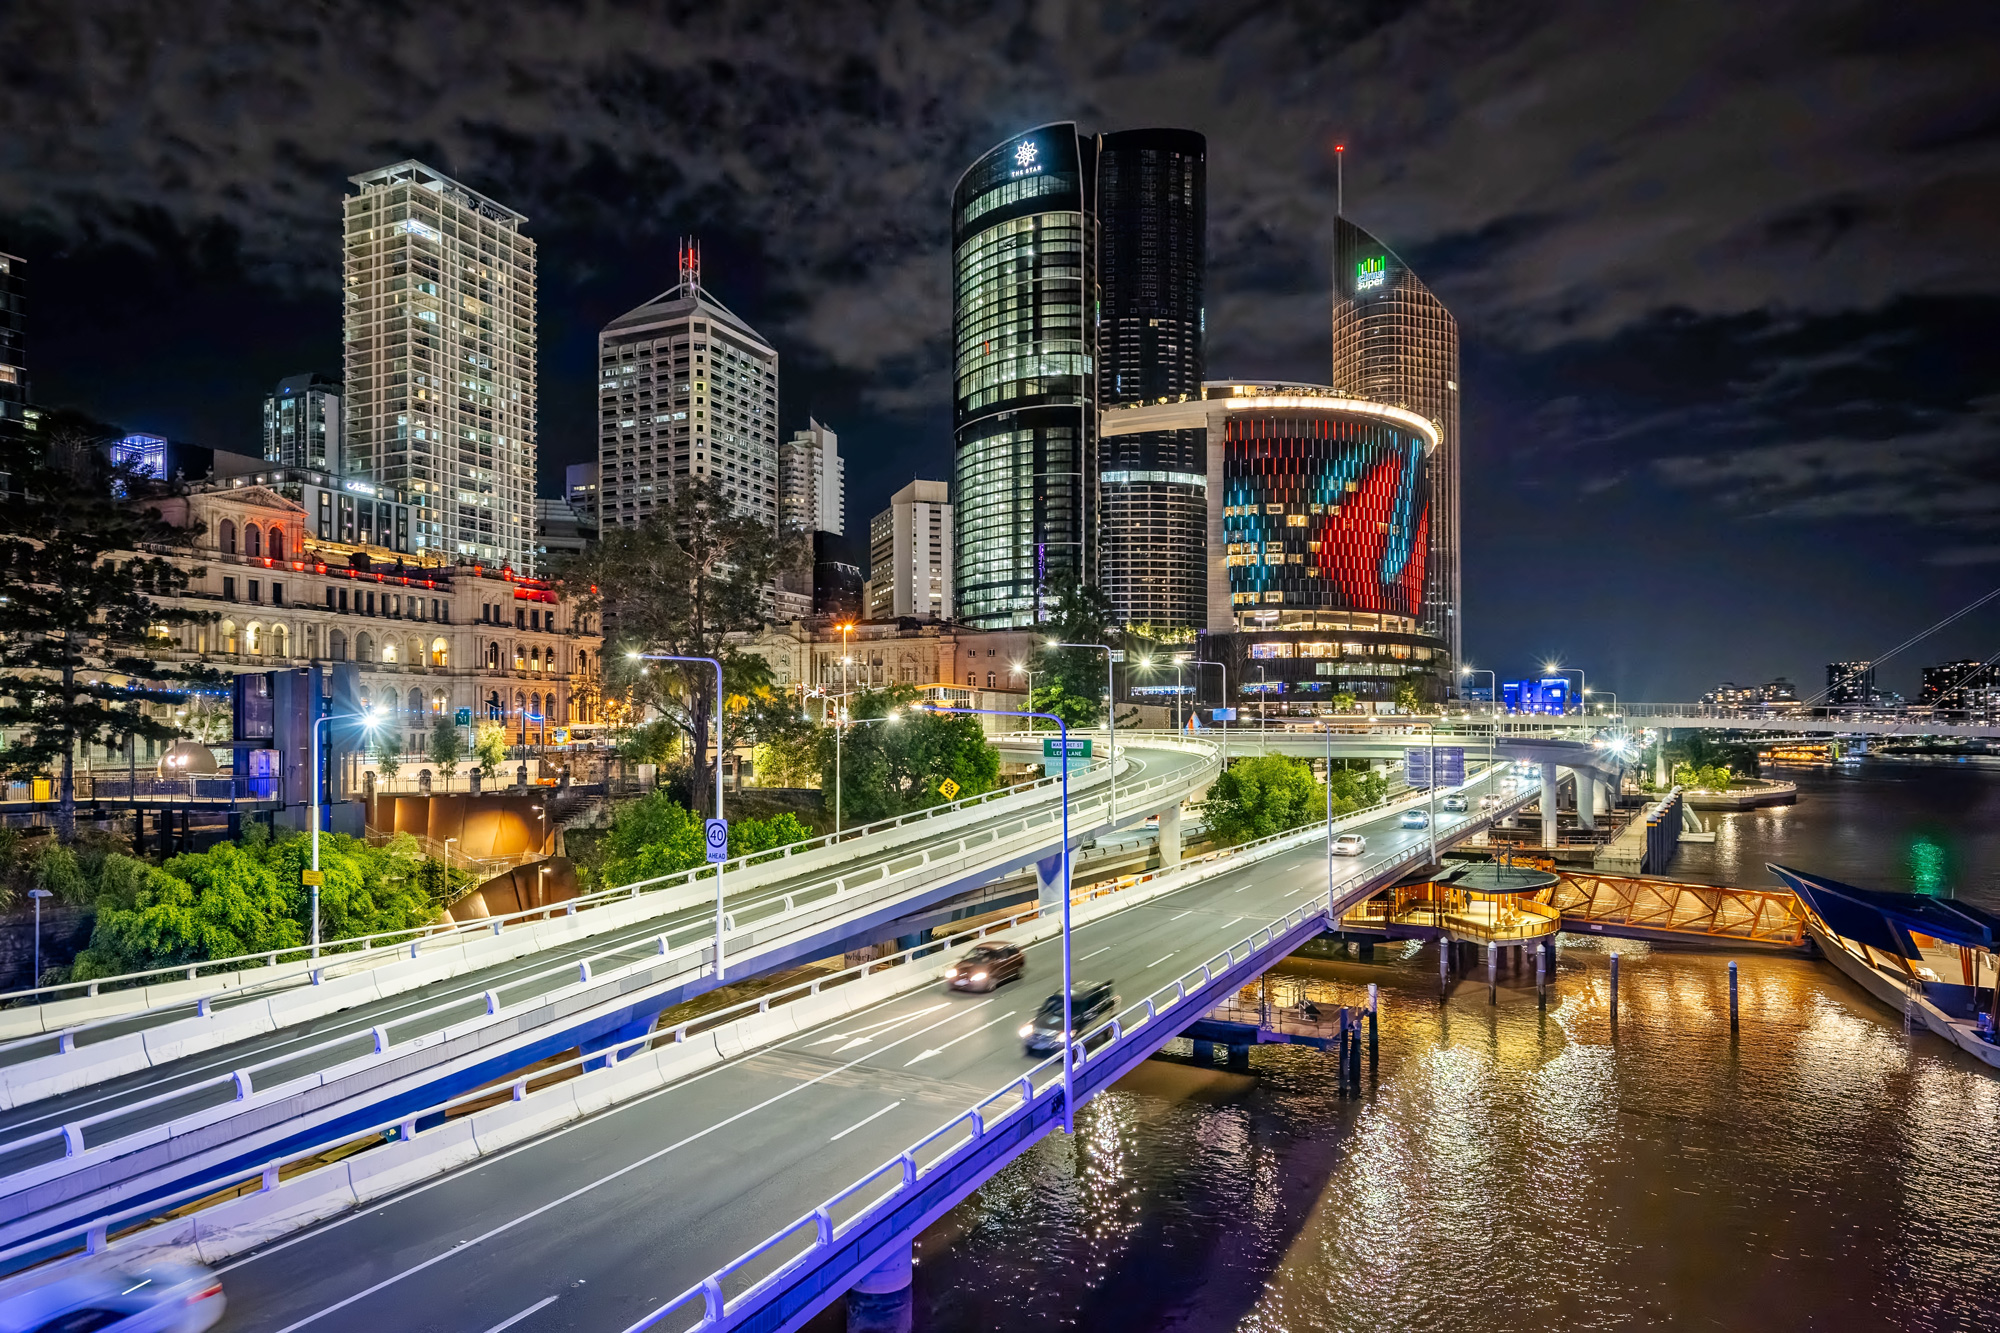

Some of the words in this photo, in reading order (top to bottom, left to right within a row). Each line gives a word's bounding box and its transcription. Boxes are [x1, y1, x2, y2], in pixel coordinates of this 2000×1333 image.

[1025, 165, 1042, 174] STAR
[1357, 278, 1385, 290] super
[710, 829, 724, 842] 40
[708, 852, 726, 860] AHEAD
